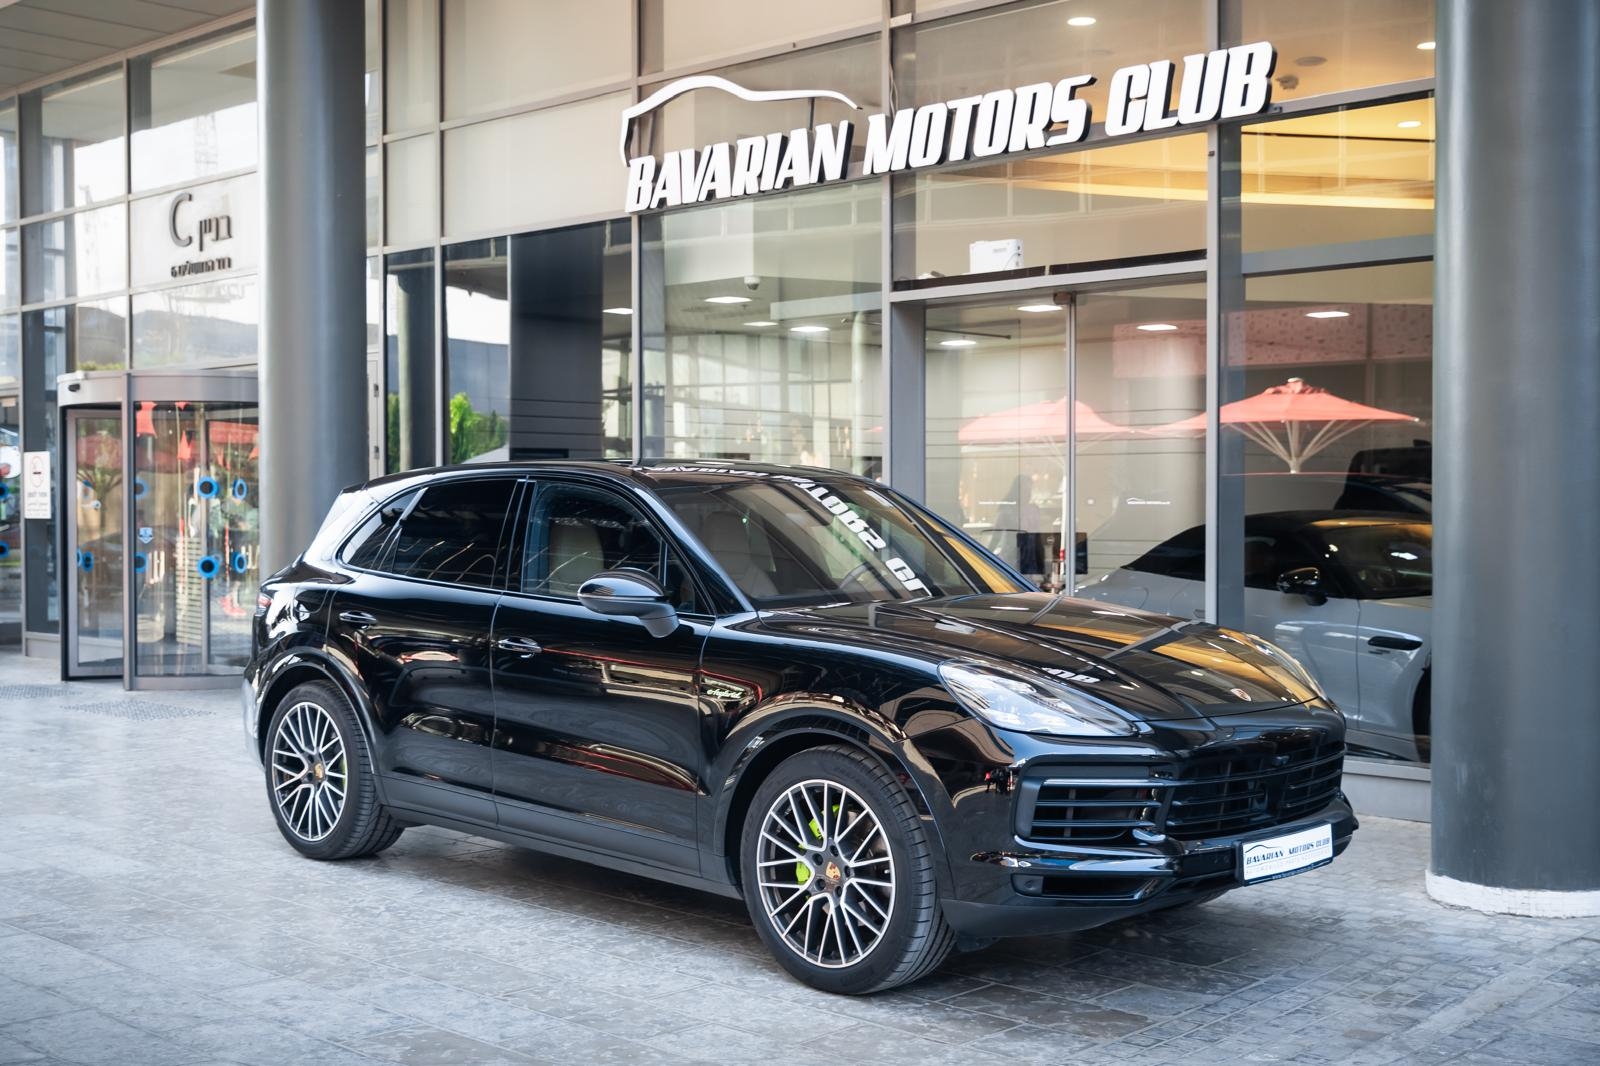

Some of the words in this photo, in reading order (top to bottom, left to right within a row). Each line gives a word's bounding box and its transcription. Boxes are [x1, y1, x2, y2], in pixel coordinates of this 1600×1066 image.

[624, 122, 850, 214] BAVARIAN
[862, 75, 1096, 173] MOTORS
[1104, 41, 1273, 136] CLUB
[169, 192, 193, 247] C
[1246, 850, 1284, 865] BAVARIAN
[1288, 841, 1315, 855] MOTORS
